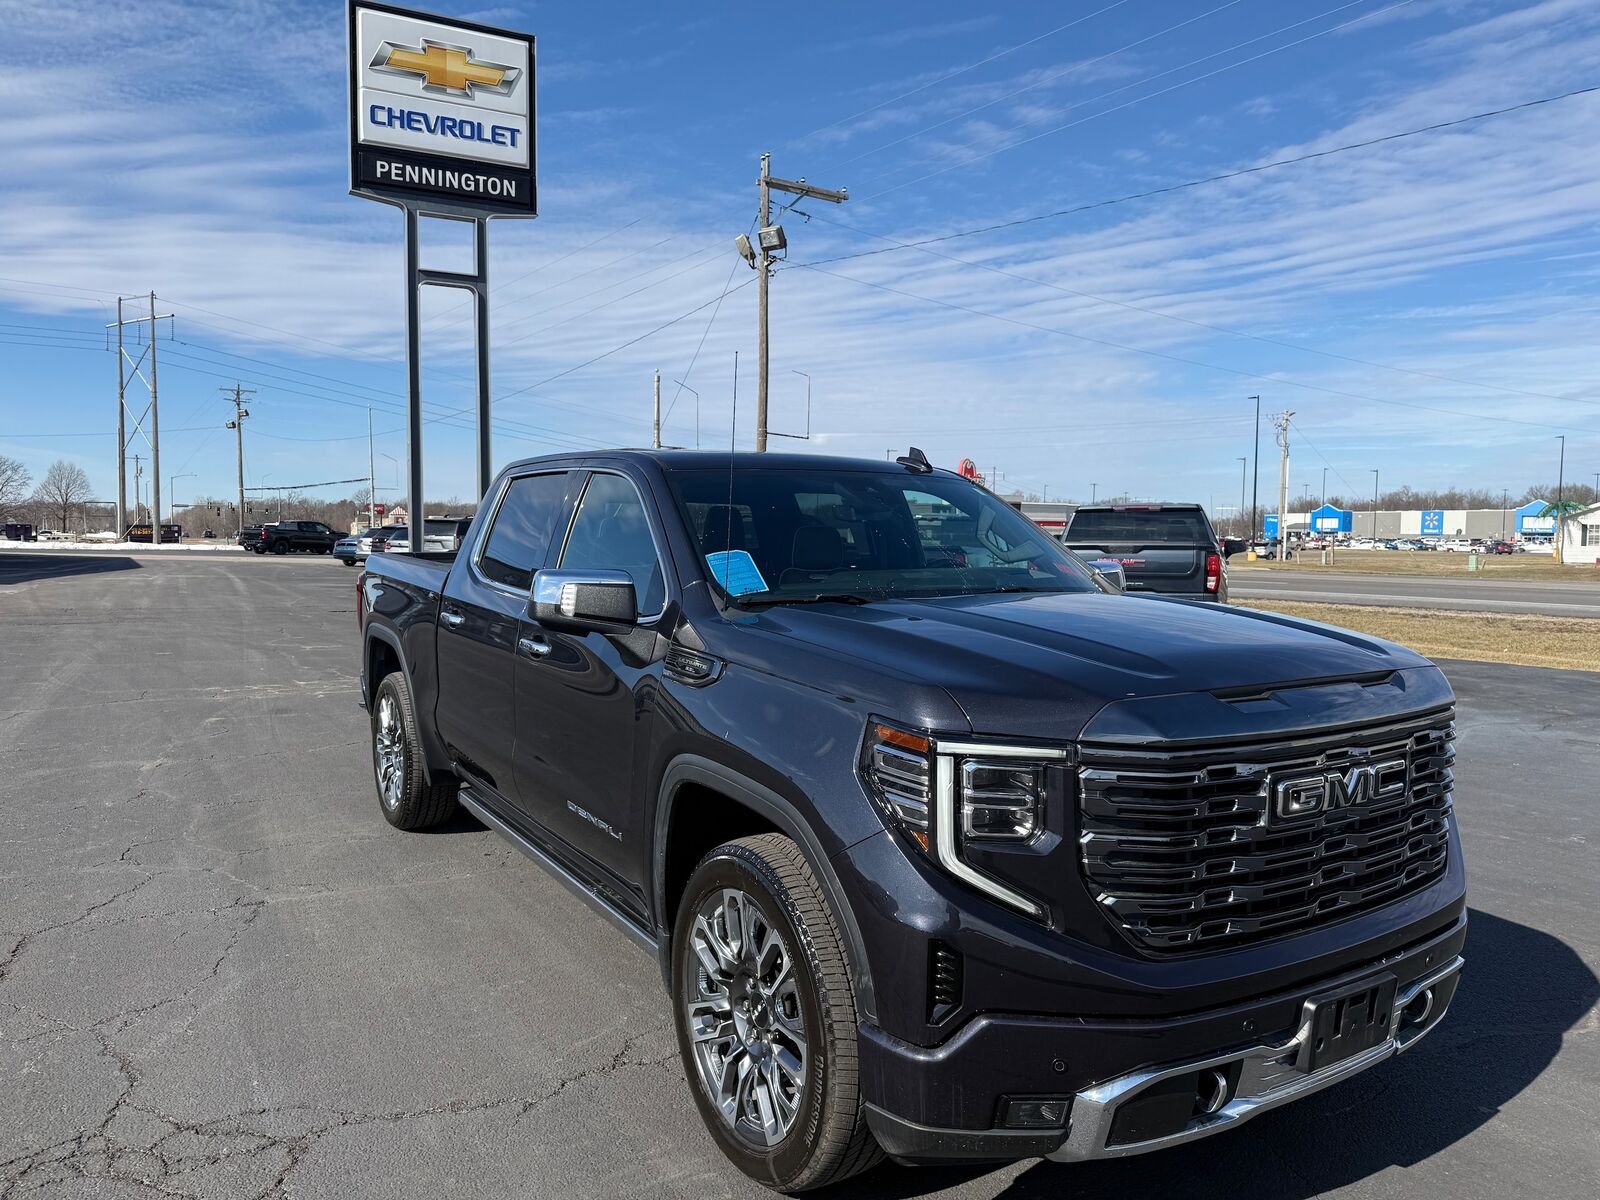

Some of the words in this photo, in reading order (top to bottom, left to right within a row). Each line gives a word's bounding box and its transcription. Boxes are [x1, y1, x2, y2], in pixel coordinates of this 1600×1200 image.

[370, 104, 520, 148] CHEVROLET
[376, 160, 516, 197] PENNINGTON
[1277, 759, 1406, 818] GMC
[566, 799, 623, 843] DENALI
